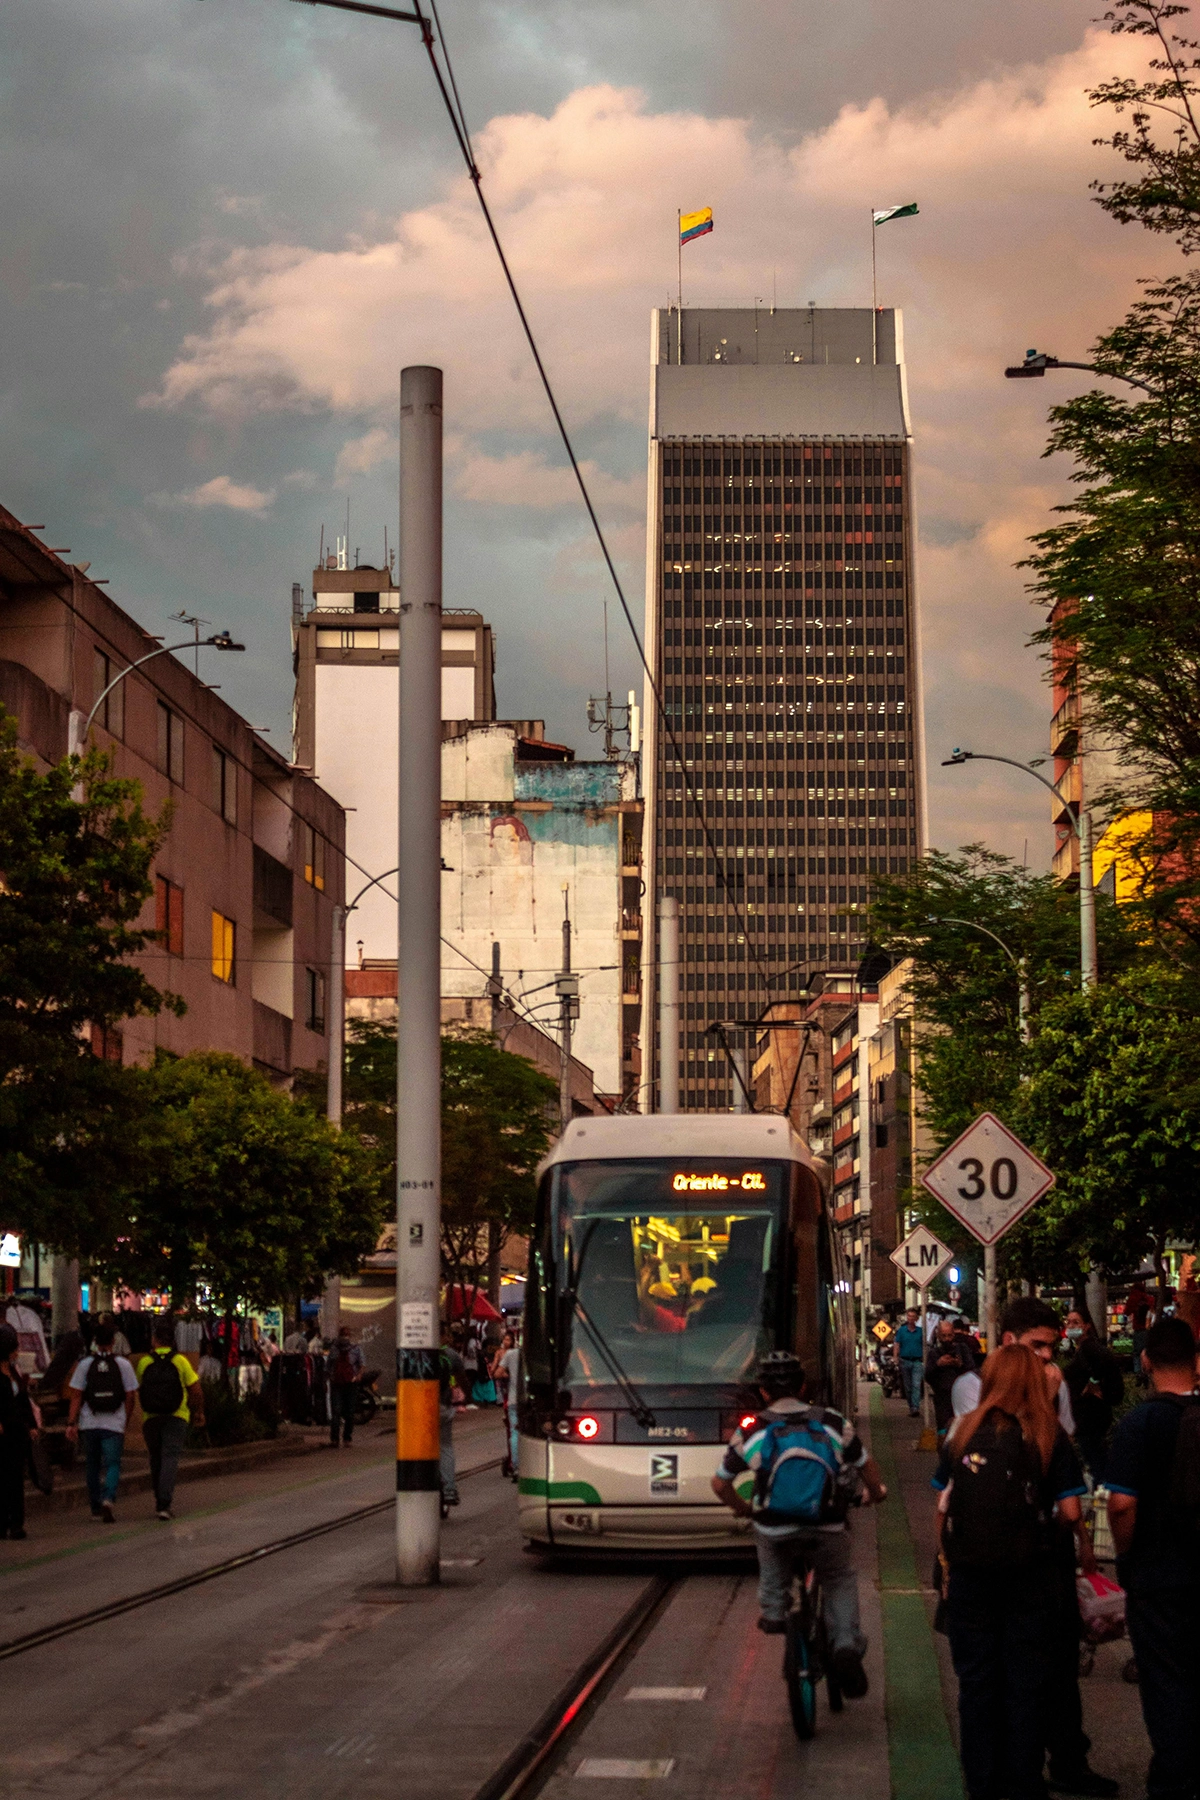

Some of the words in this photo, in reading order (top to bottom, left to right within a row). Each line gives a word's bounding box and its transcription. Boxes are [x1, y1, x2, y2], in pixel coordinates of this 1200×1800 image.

[673, 1173, 728, 1191] Oriente
[957, 1157, 1018, 1200] 30
[904, 1244, 938, 1267] LM
